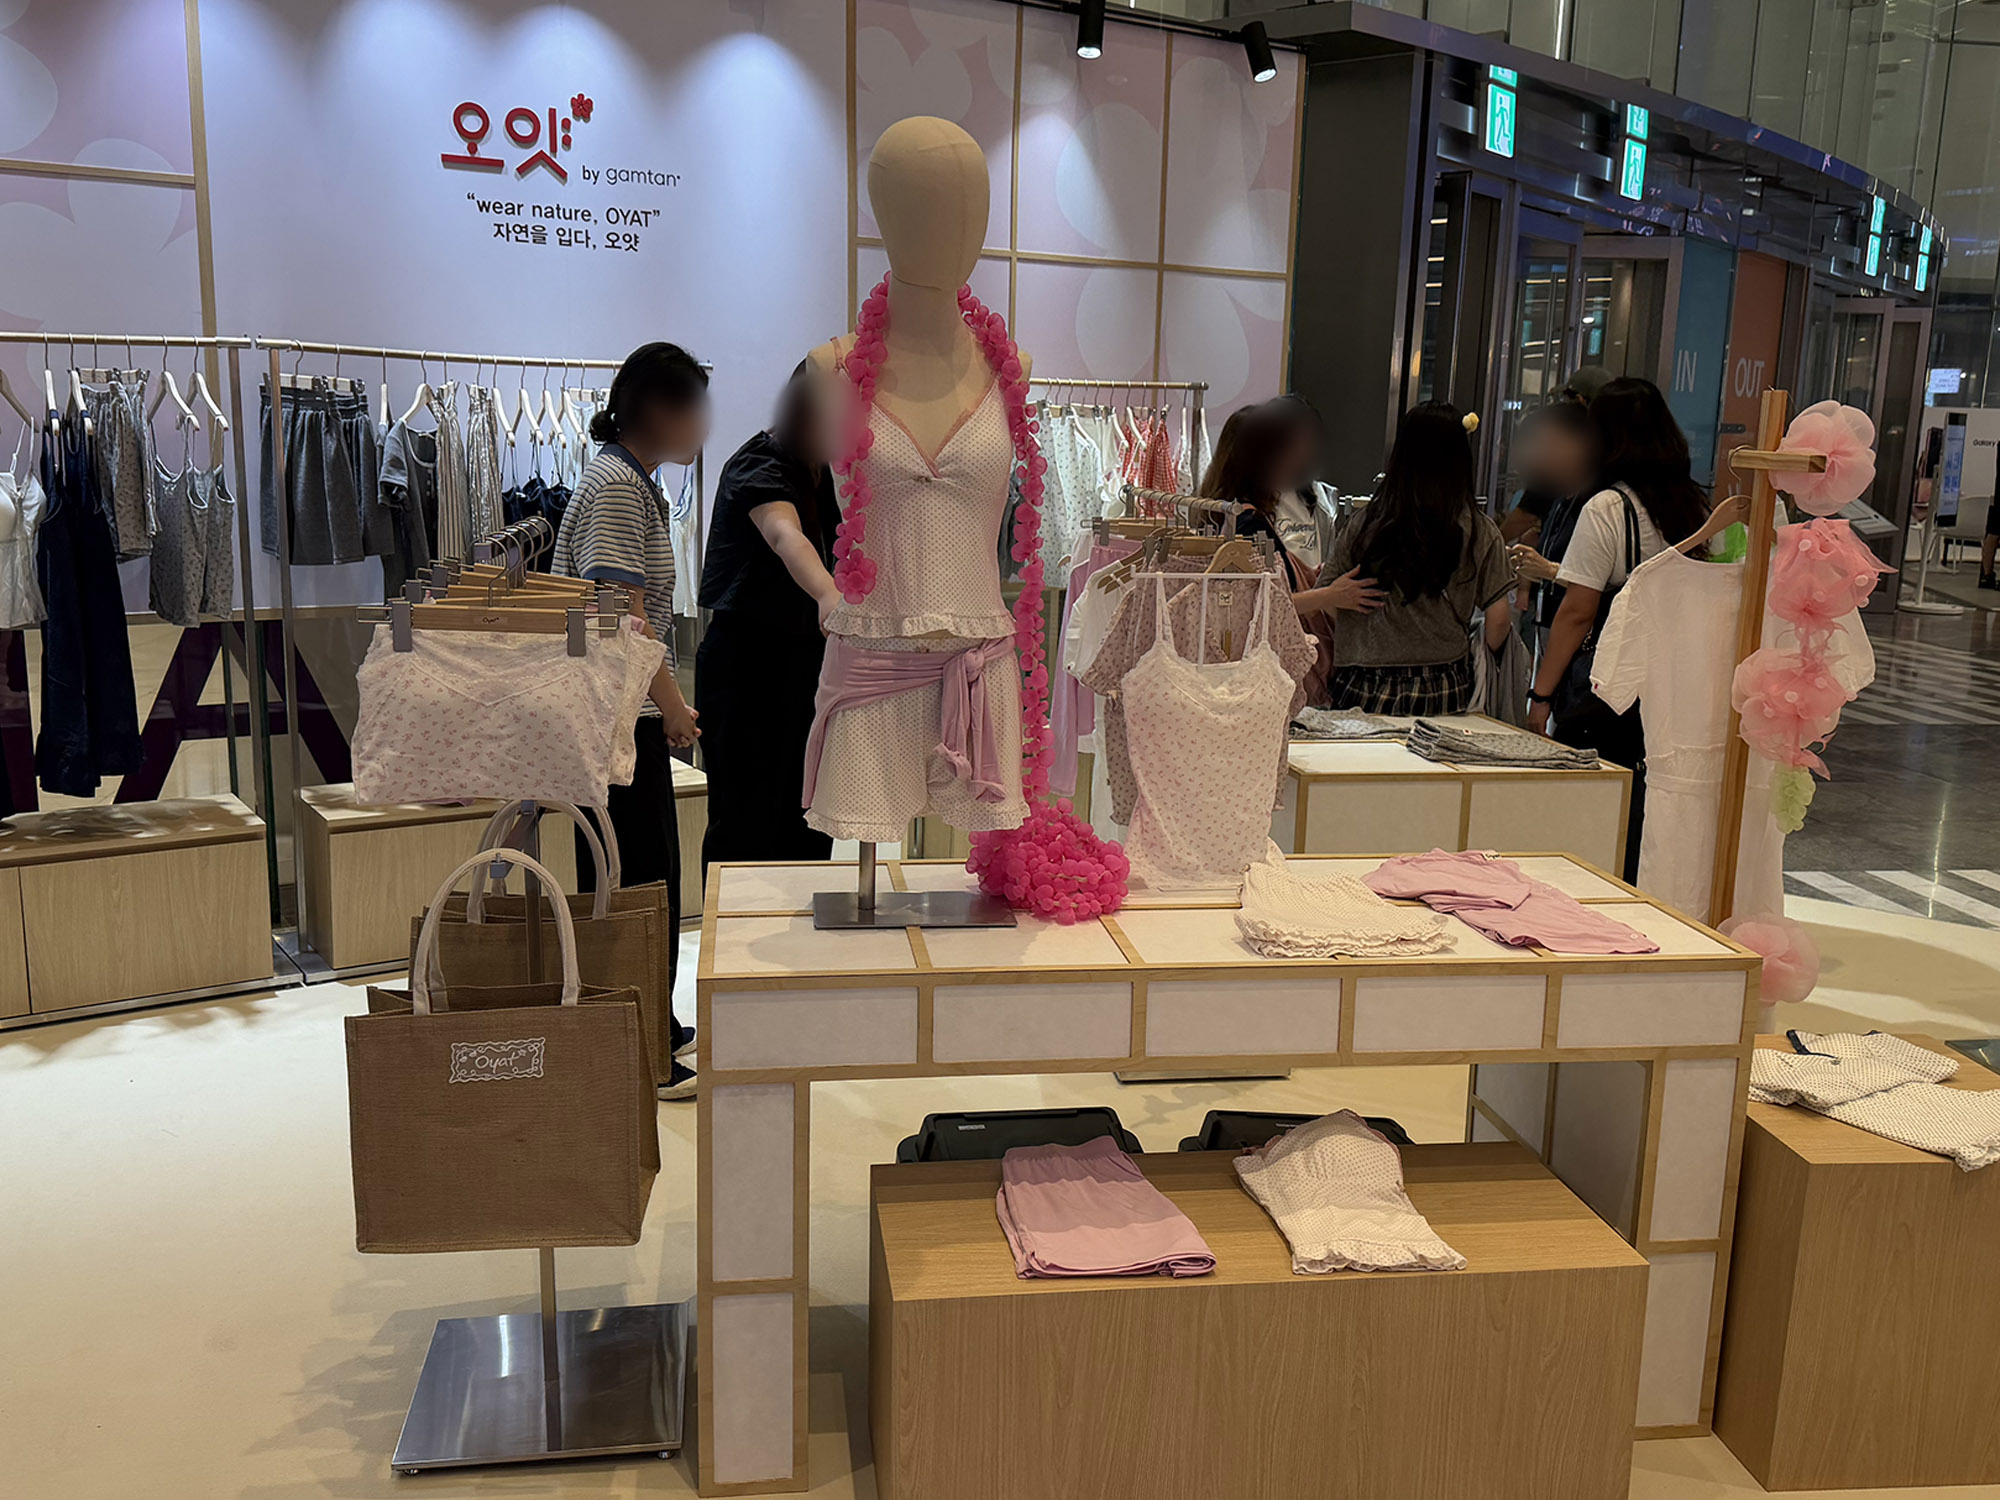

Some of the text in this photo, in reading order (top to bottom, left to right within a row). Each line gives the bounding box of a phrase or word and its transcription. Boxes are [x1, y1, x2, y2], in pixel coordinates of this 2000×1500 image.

[441, 102, 572, 181] 오얏
[582, 165, 600, 185] by
[532, 203, 598, 225] nature,
[493, 222, 640, 252] 자연을 입다, 오얏
[1675, 350, 1698, 393] IN
[1734, 357, 1765, 398] OUT
[475, 1051, 519, 1074] Oyat
